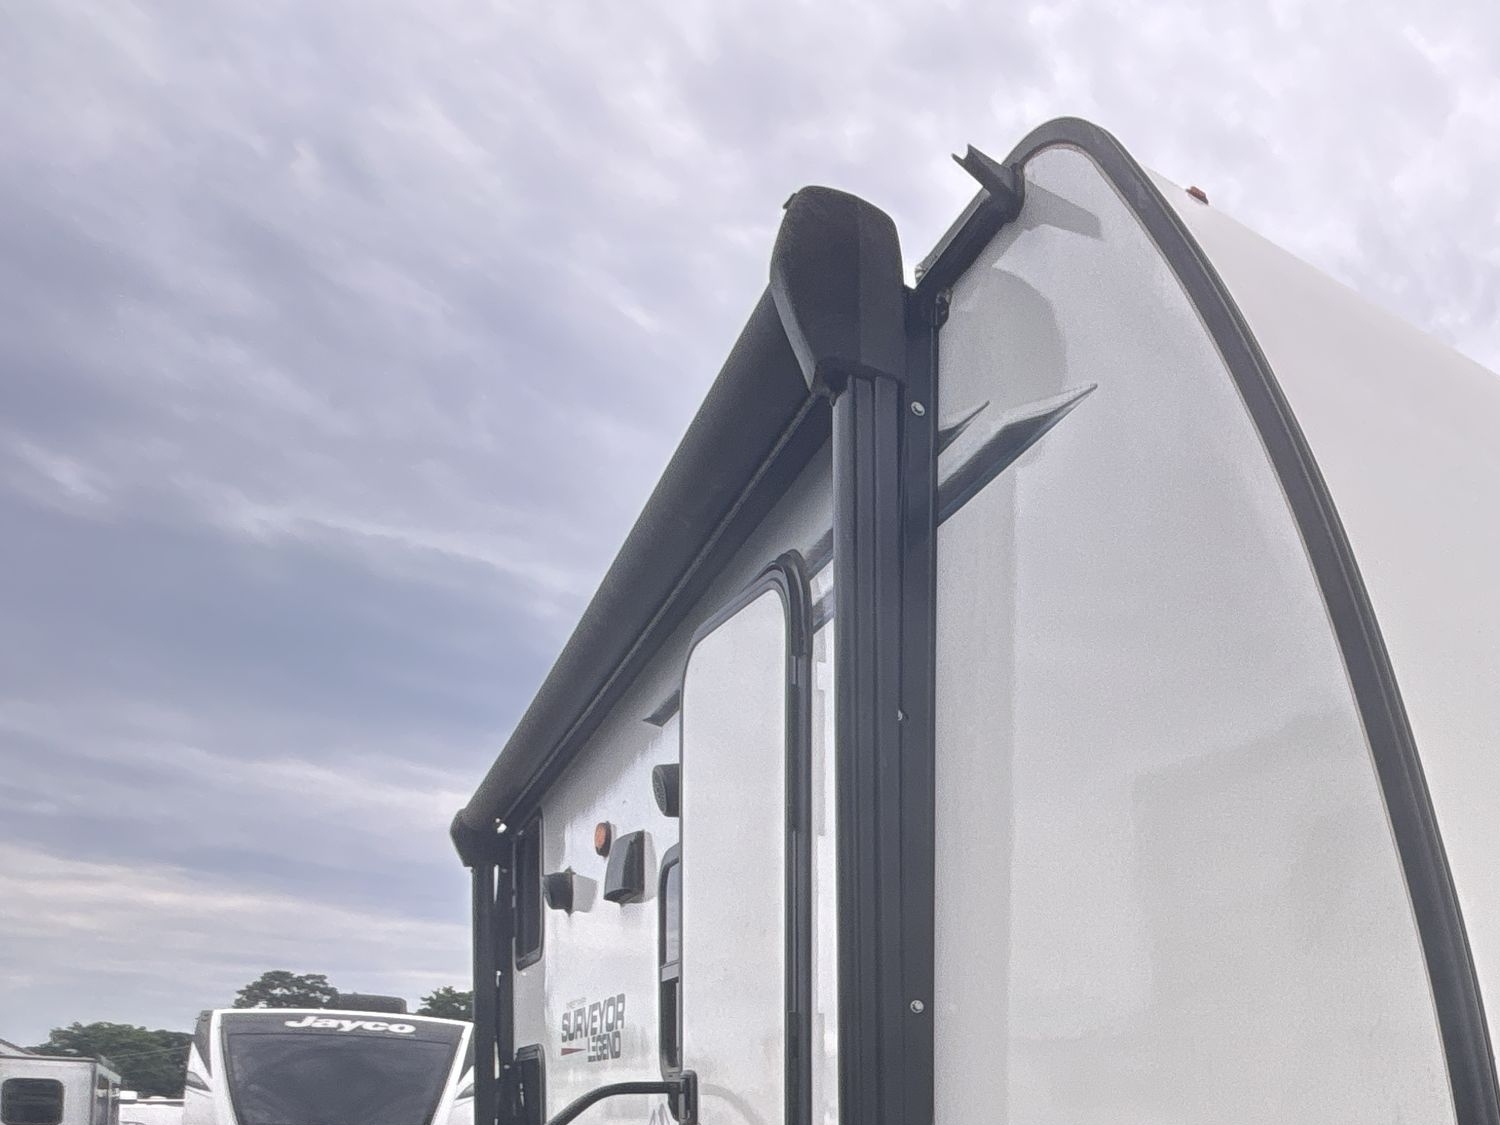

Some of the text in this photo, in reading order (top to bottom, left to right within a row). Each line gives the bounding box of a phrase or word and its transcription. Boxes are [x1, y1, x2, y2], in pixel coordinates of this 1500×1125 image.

[284, 1015, 417, 1034] Jayco
[561, 993, 626, 1043] SURVEYOR
[587, 1030, 622, 1063] LEGEND
